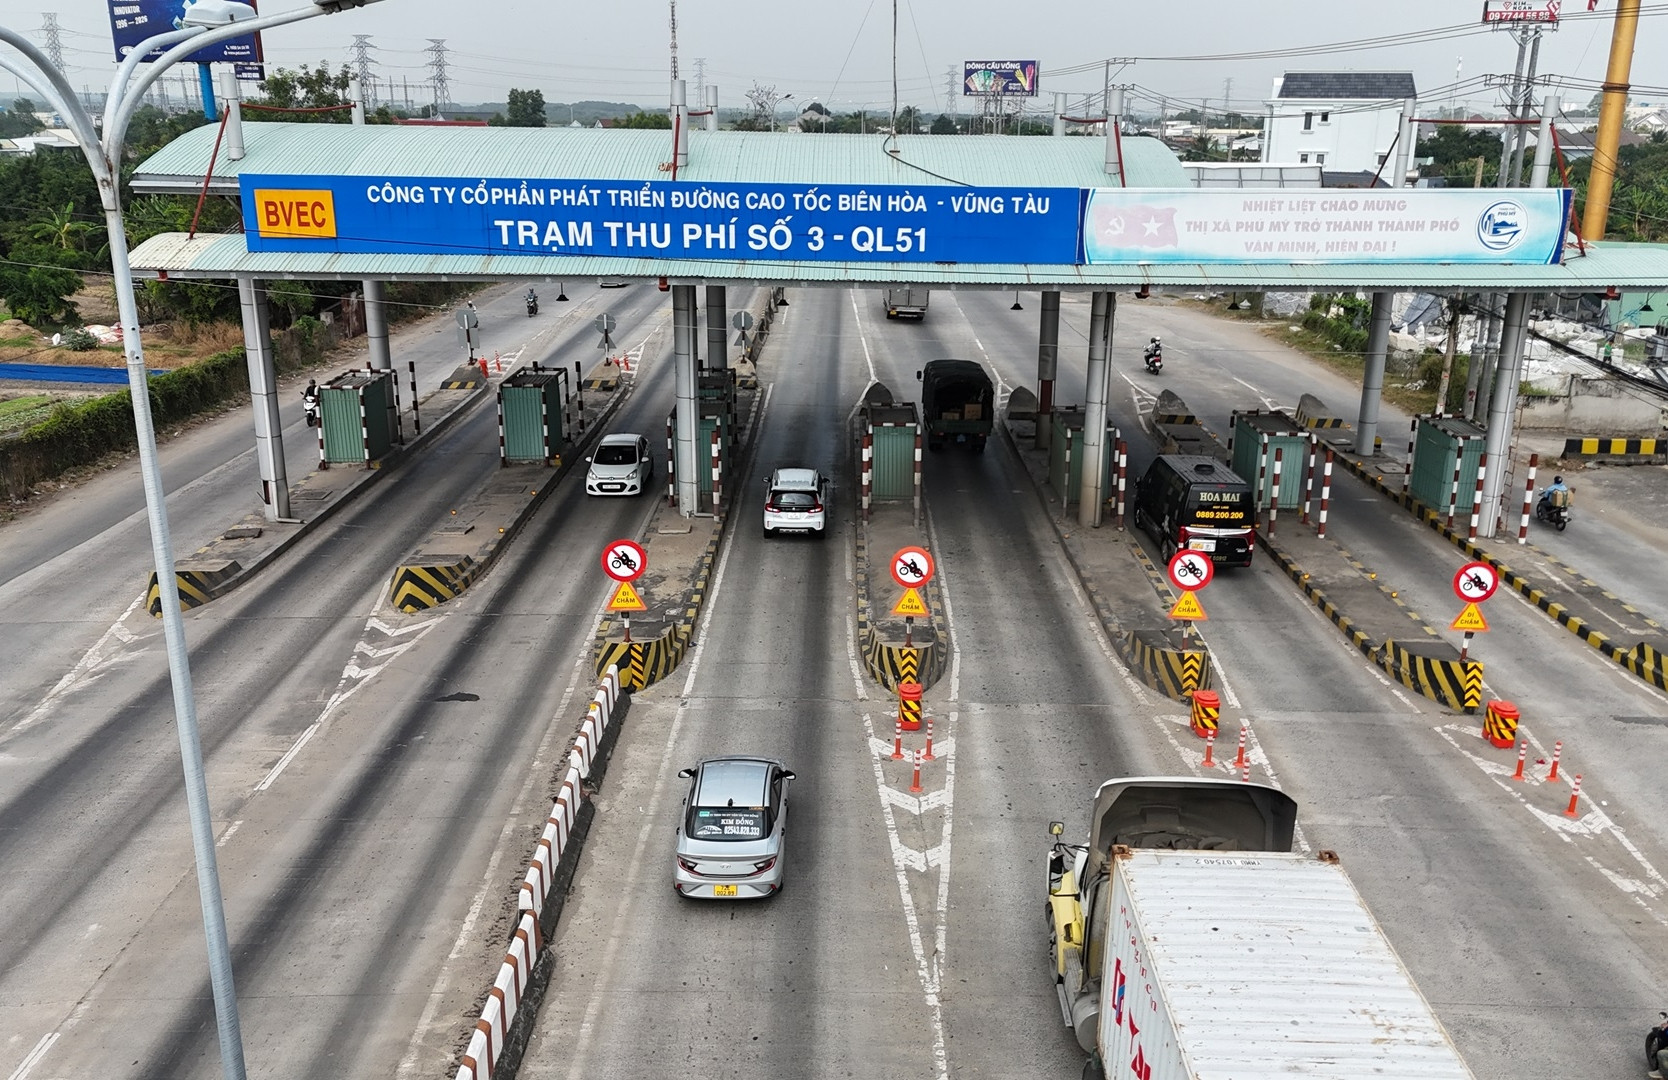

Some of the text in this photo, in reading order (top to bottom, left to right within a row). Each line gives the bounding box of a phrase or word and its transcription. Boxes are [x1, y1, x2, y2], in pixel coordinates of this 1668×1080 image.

[113, 5, 140, 15] INNOVATOR
[367, 182, 424, 204] CÔNG
[430, 187, 456, 204] TY
[461, 180, 489, 205] CỔ
[491, 181, 545, 206] PHẦN
[550, 185, 601, 207] PHÁT
[607, 182, 665, 208] TRIỂN
[671, 187, 740, 209] ĐƯỜNG
[745, 193, 785, 210] CAO
[792, 187, 831, 211] TỐC
[838, 190, 881, 212] BIÊN
[888, 191, 927, 212] HÒA
[951, 193, 1004, 214] VŨNG
[1012, 194, 1050, 214] TÀU
[1242, 197, 1284, 215] NHIỆT
[1288, 197, 1316, 215] LIỆT
[264, 200, 326, 228] BVEC
[494, 220, 593, 251] TRẠM
[603, 221, 671, 248] THU
[683, 216, 738, 249] PHÍ
[748, 215, 793, 250] SỐ
[807, 226, 824, 251] 3
[851, 226, 926, 253] QL51
[1185, 220, 1208, 235] THỊ
[1429, 216, 1460, 232] PHỐ
[1278, 241, 1320, 255] MINH,
[1324, 239, 1358, 254] HIỆN
[1362, 241, 1387, 255] ĐẠI
[1200, 492, 1240, 502] HOA MAI
[1178, 606, 1197, 614] CHẬM
